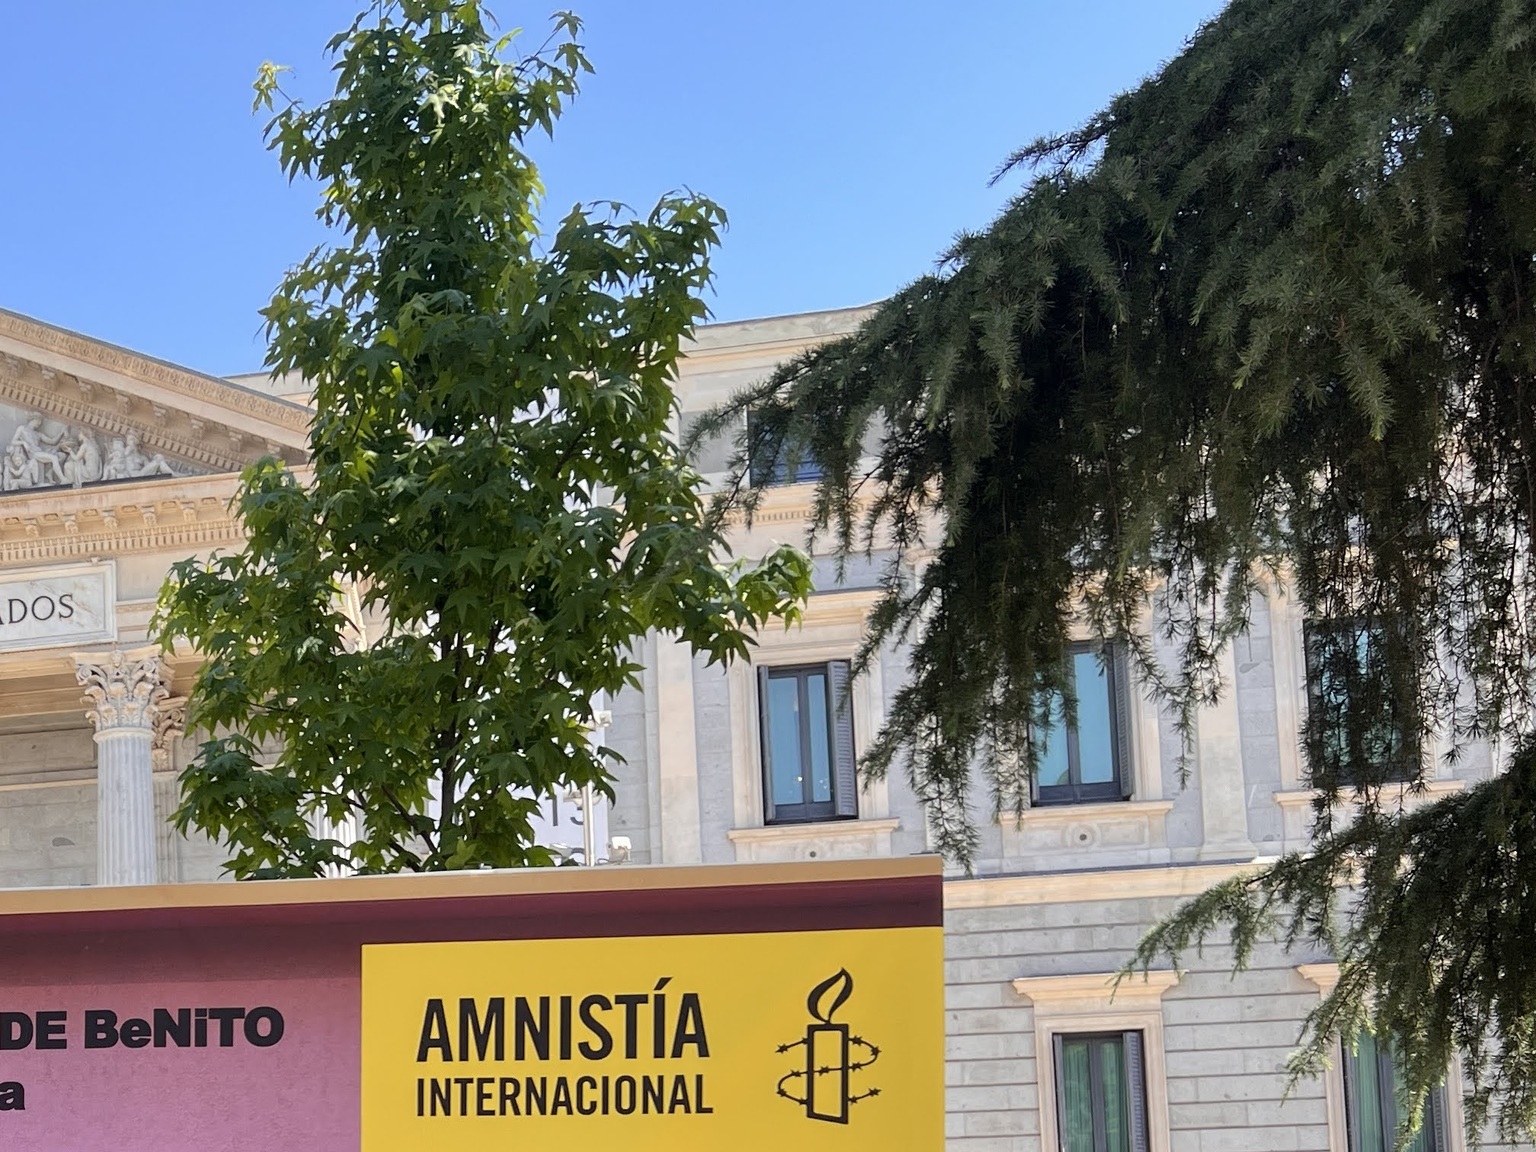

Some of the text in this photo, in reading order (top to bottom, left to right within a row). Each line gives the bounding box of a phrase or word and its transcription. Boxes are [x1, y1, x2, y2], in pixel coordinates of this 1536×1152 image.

[84, 1006, 286, 1049] BeNiTO
[416, 977, 710, 1063] AMNISTÍA
[417, 1074, 714, 1117] INTERNACIONAL
